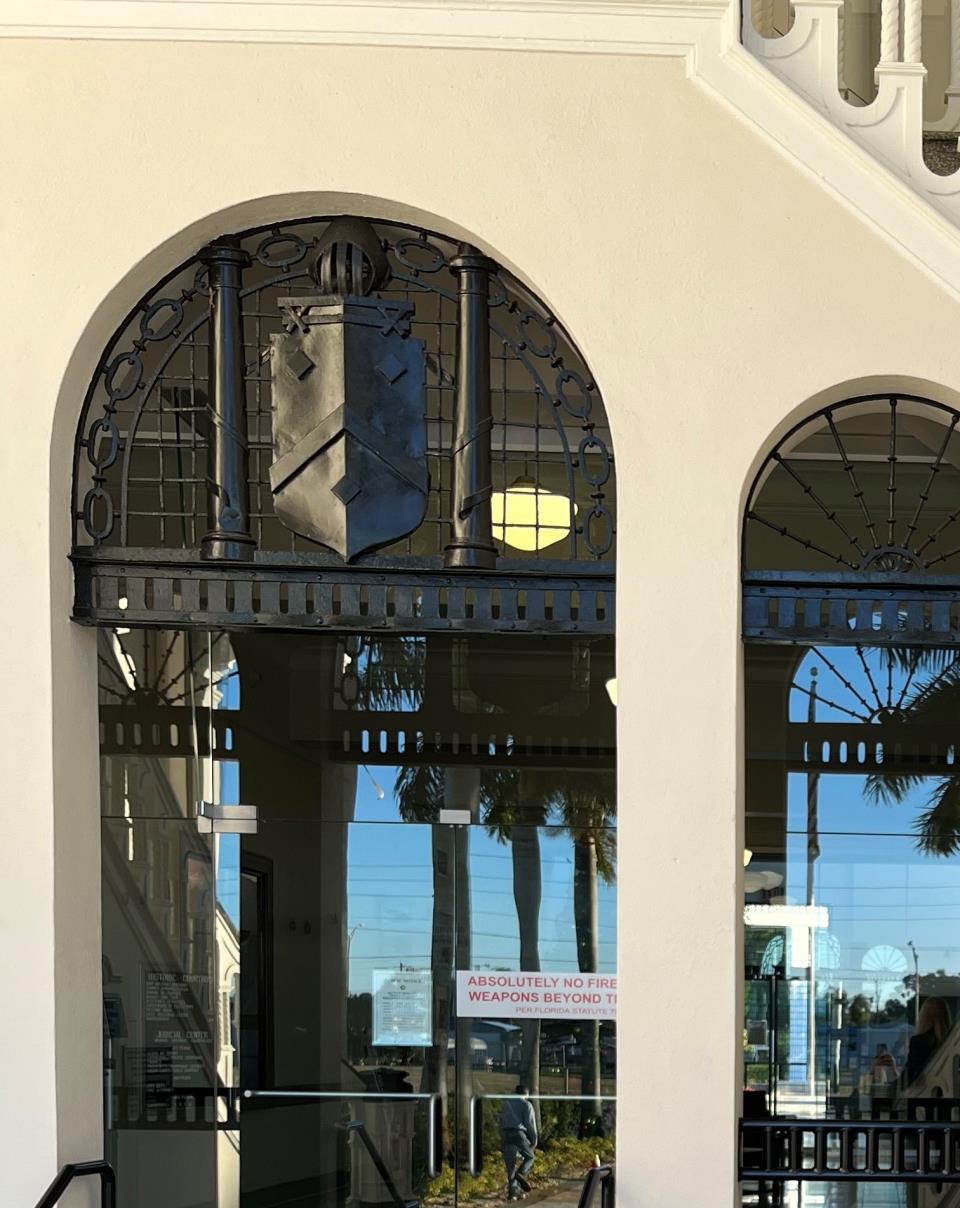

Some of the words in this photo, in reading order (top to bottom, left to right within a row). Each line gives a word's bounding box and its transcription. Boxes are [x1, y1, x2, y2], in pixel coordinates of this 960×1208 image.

[467, 976, 560, 988] ABSOLUTELY
[564, 978, 584, 988] NO
[588, 978, 617, 989] FIRE
[468, 991, 540, 1003] WEAPONS
[543, 993, 602, 1004] BEYOND
[534, 1007, 570, 1015] FLORIDA
[571, 1008, 608, 1016] STATUTE
